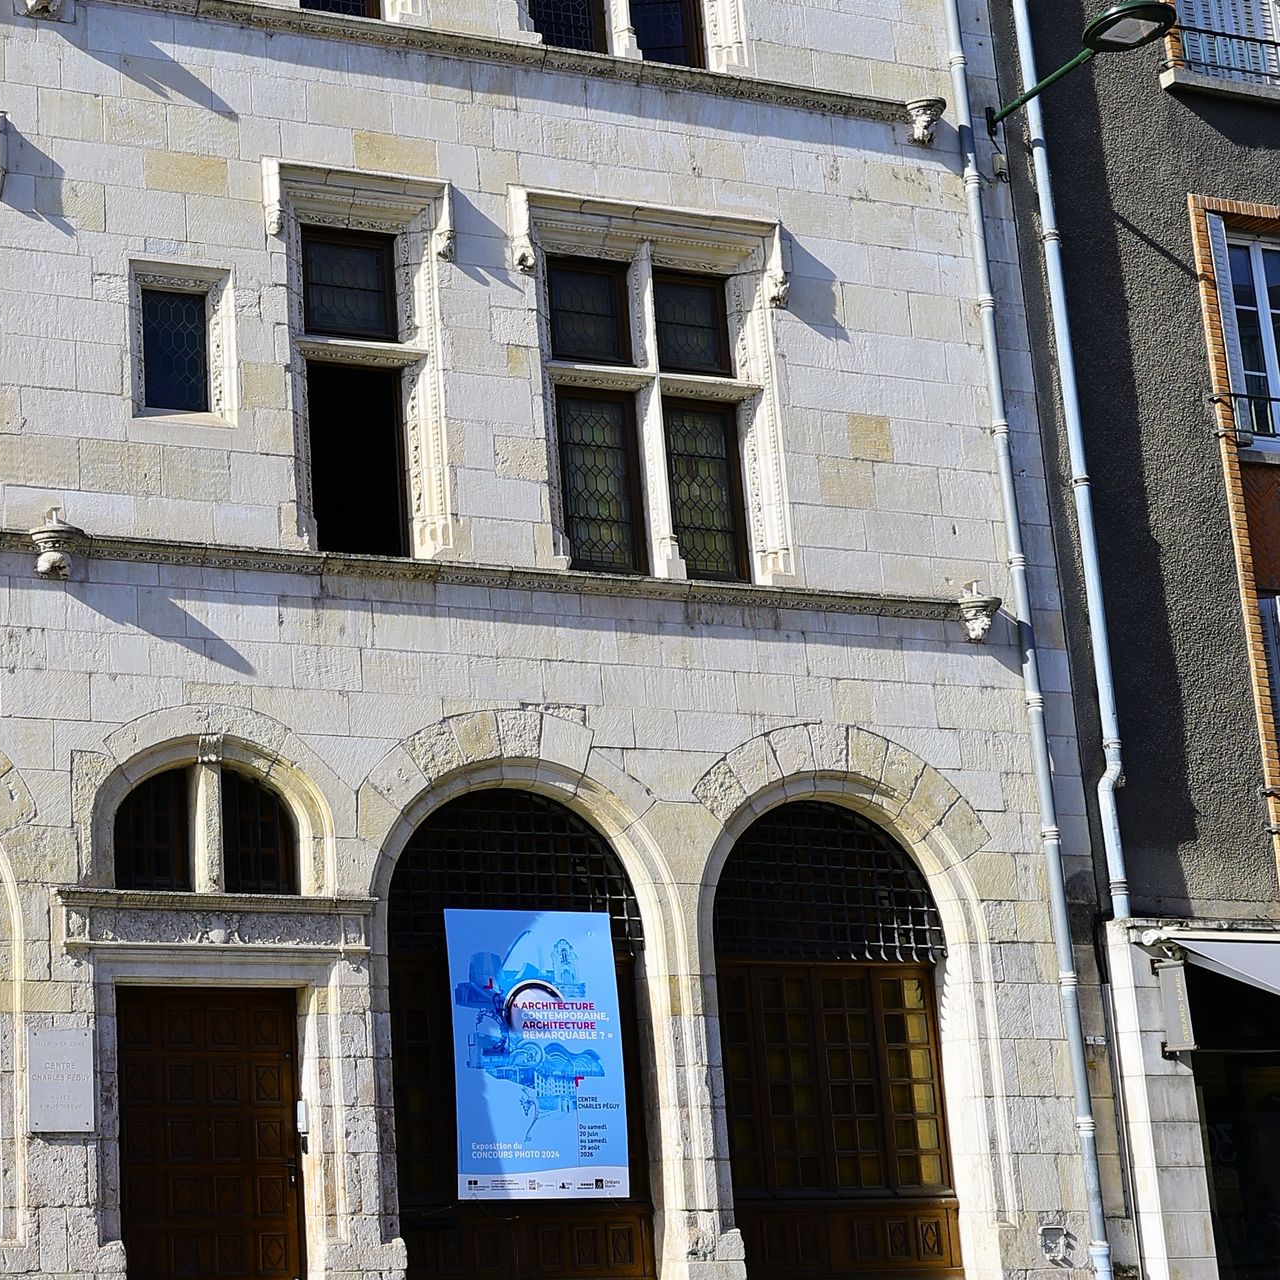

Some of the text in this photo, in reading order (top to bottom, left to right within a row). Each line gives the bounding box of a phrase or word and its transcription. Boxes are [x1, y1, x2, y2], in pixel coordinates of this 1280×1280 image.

[521, 1001, 595, 1010] ARCHITECTURE
[521, 1011, 610, 1022] CONTEMPORAINE,
[522, 1021, 596, 1030] ARCHITECTURE
[523, 1031, 597, 1040] REMARQUABLE
[44, 1062, 76, 1070] CENTRE
[31, 1073, 65, 1081] CHARLES
[602, 1102, 620, 1110] PÉGUY
[471, 1142, 523, 1151] Exposition du
[471, 1150, 513, 1159] CONCOURS
[514, 1150, 540, 1159] PHOTO
